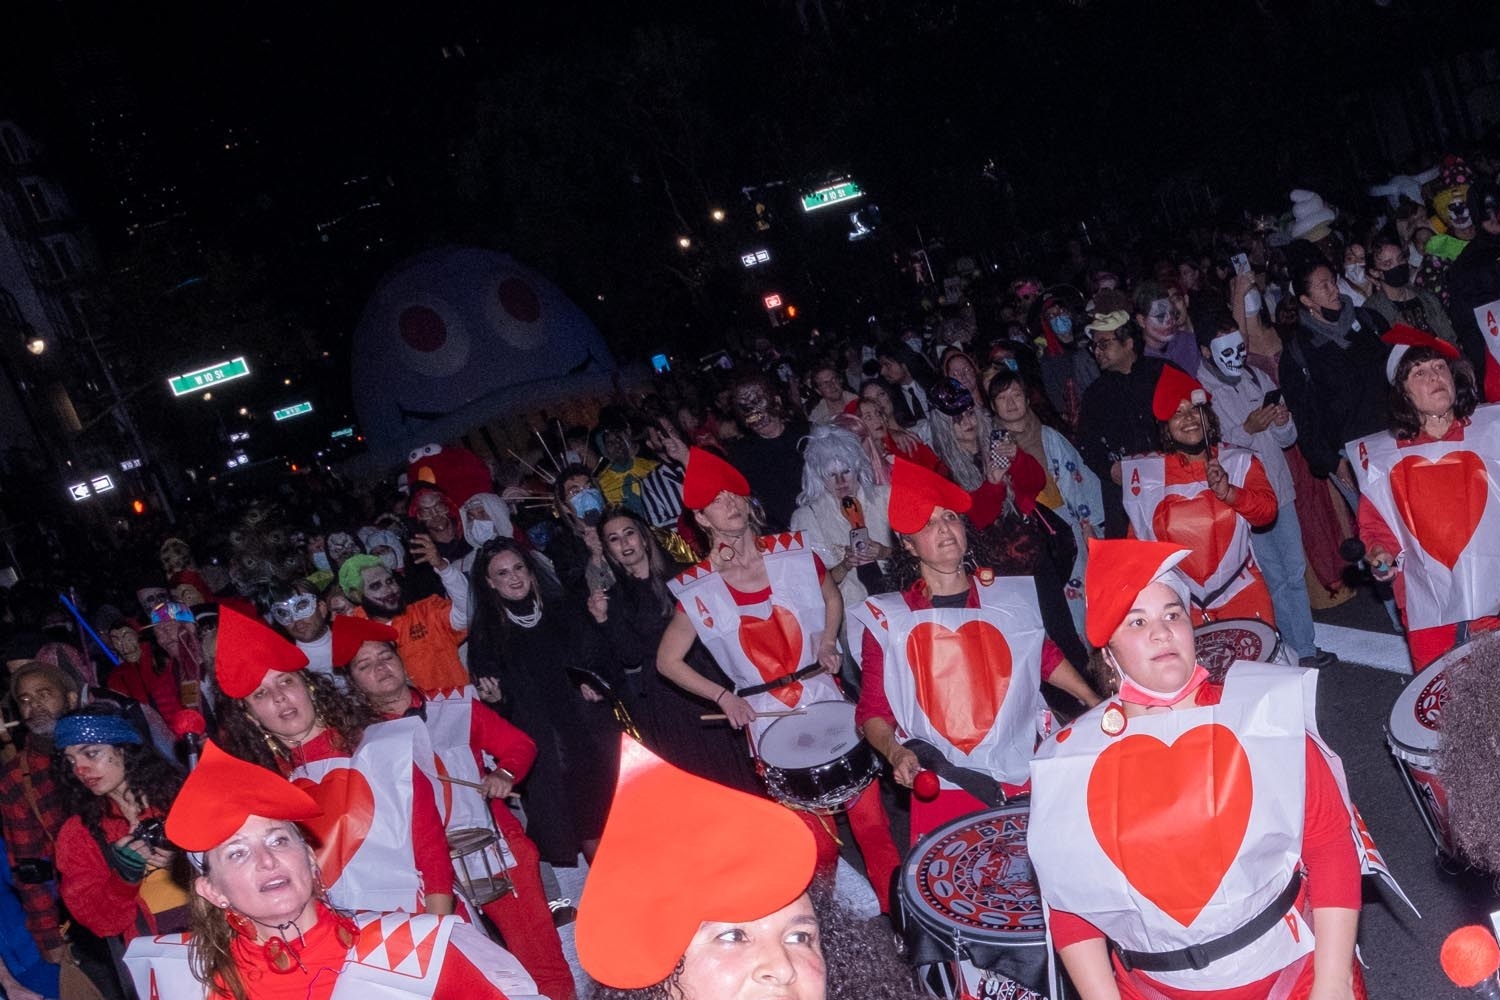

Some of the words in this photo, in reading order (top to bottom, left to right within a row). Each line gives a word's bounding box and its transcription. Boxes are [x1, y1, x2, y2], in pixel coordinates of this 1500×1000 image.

[1487, 310, 1497, 327] A
[194, 376, 203, 385] W
[203, 373, 214, 382] 10
[1130, 467, 1141, 485] A
[694, 595, 710, 617] A
[864, 600, 886, 620] A
